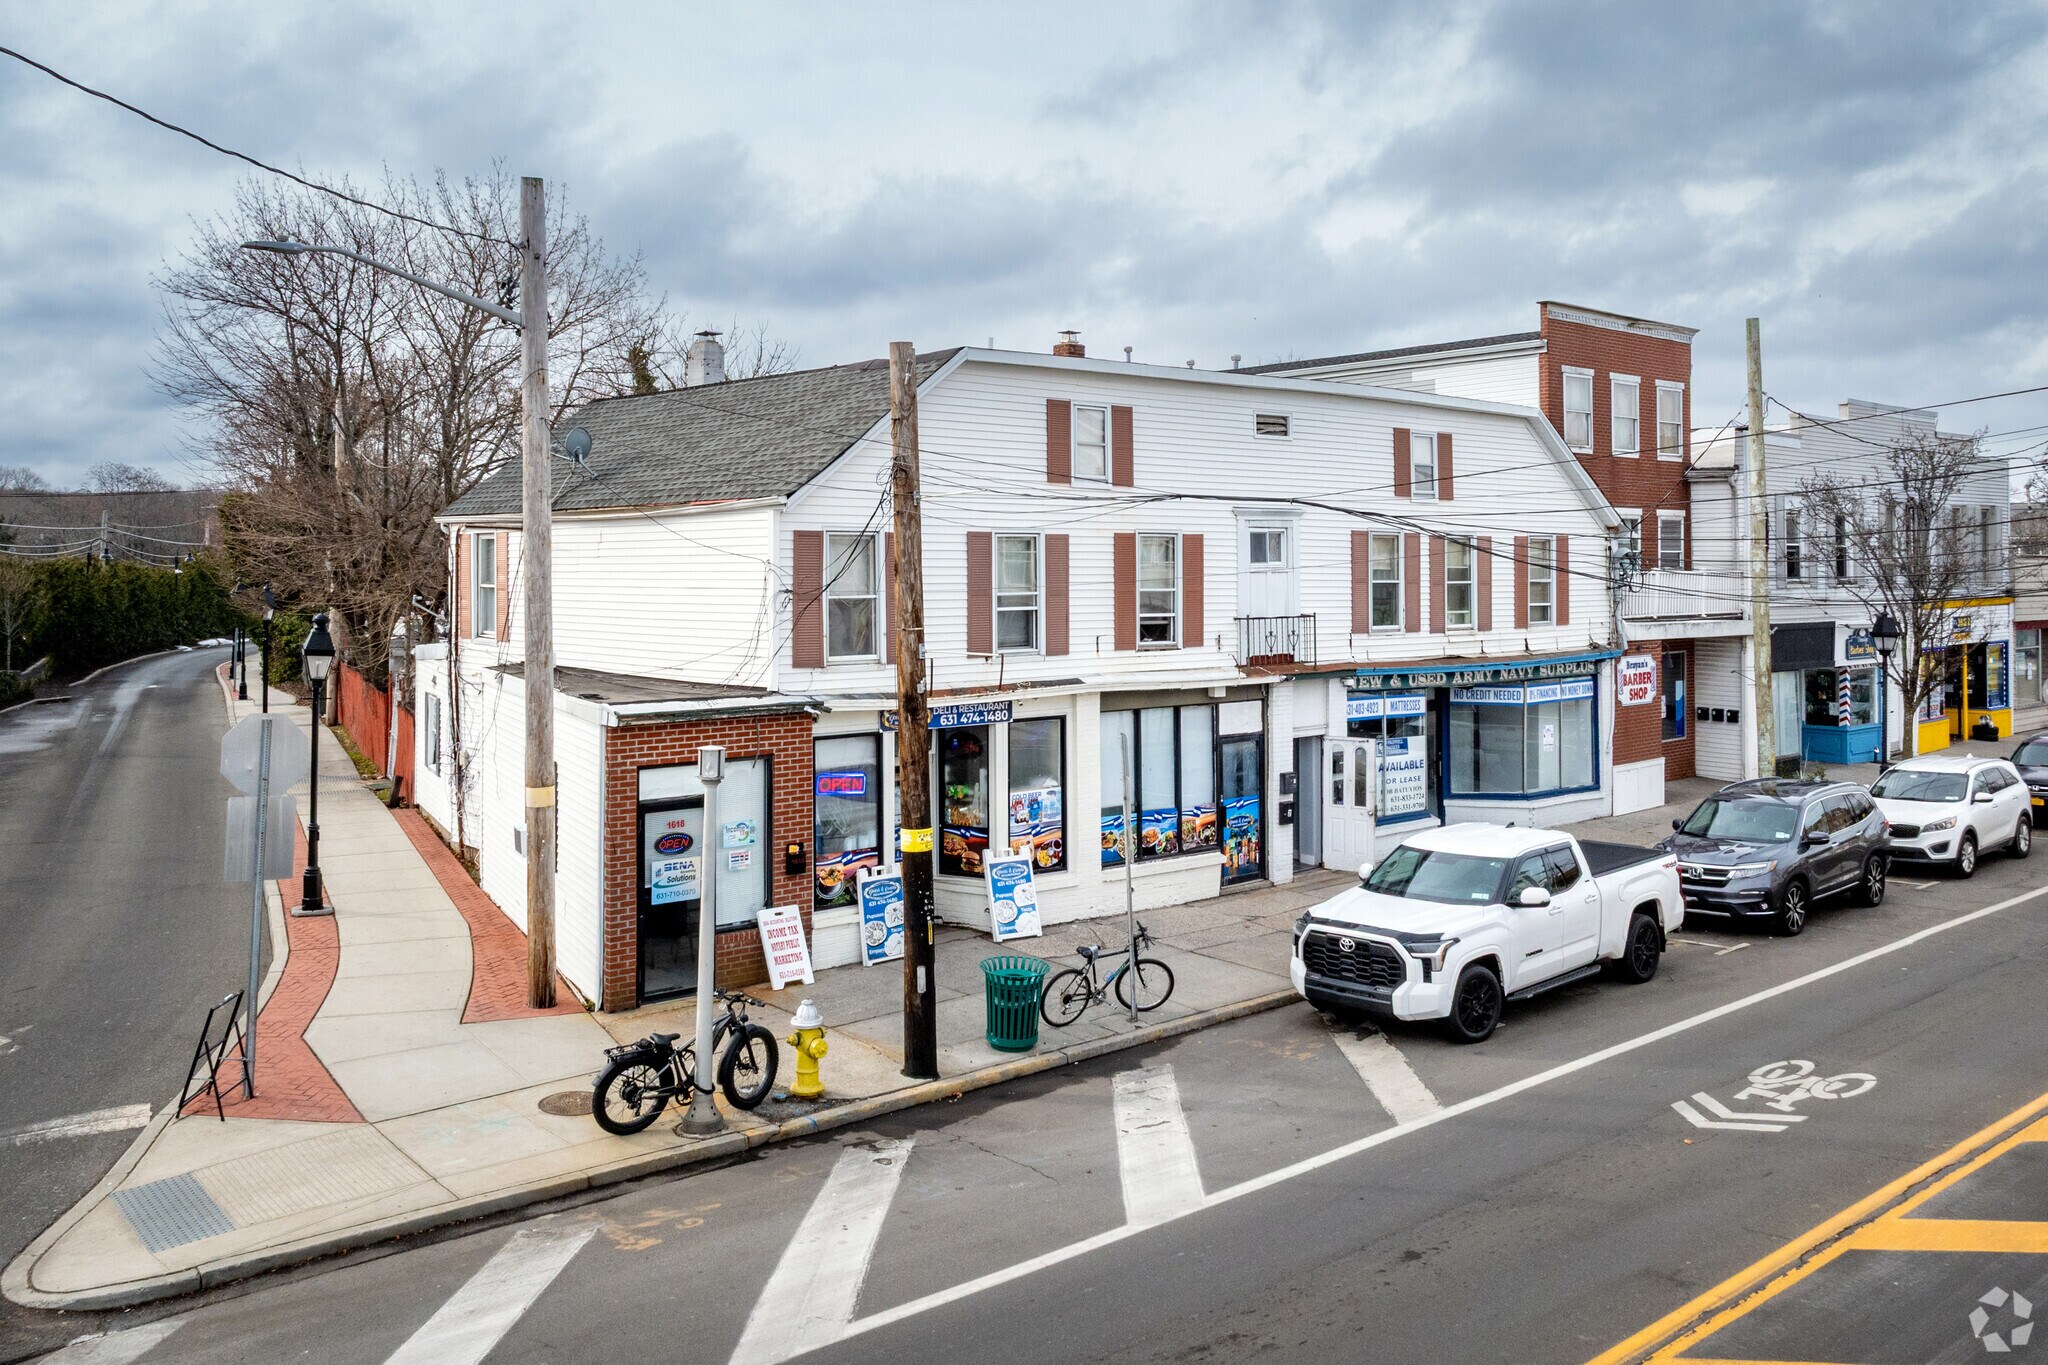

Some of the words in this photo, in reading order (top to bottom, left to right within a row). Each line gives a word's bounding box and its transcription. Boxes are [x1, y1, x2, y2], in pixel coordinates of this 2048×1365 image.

[1390, 674, 1400, 688] &
[1408, 672, 1447, 686] USED
[1452, 670, 1494, 684] ARMY
[1500, 666, 1534, 680] NAVY
[1539, 661, 1595, 676] SURPLUS
[1623, 672, 1652, 686] BARBER
[1453, 689, 1463, 699] NO
[1465, 688, 1492, 700] CREDIT
[1493, 689, 1521, 701] NEEDED
[1536, 687, 1558, 699] FINANCING
[1561, 686, 1568, 696] NO
[1568, 684, 1581, 695] MONEY
[1581, 683, 1593, 694] DOWN
[1629, 687, 1648, 701] SHOP
[933, 706, 952, 716] DELI
[952, 706, 958, 714] &
[958, 701, 1010, 713] RESTAURANT
[1389, 700, 1421, 712] MATTRESSES
[940, 714, 957, 726] 631
[960, 710, 1009, 724] 474-1480
[1378, 759, 1425, 773] AVAILABLE
[818, 777, 863, 793] OPEN
[1399, 775, 1422, 784] LEASE
[667, 819, 685, 829] 1618
[659, 838, 690, 849] OPEN
[664, 860, 695, 872] SENA
[667, 873, 697, 884] Solutions
[656, 888, 697, 900] 631-710-0370
[767, 926, 787, 940] INCOME
[787, 924, 799, 936] TAX
[773, 951, 804, 966] MARKETING
